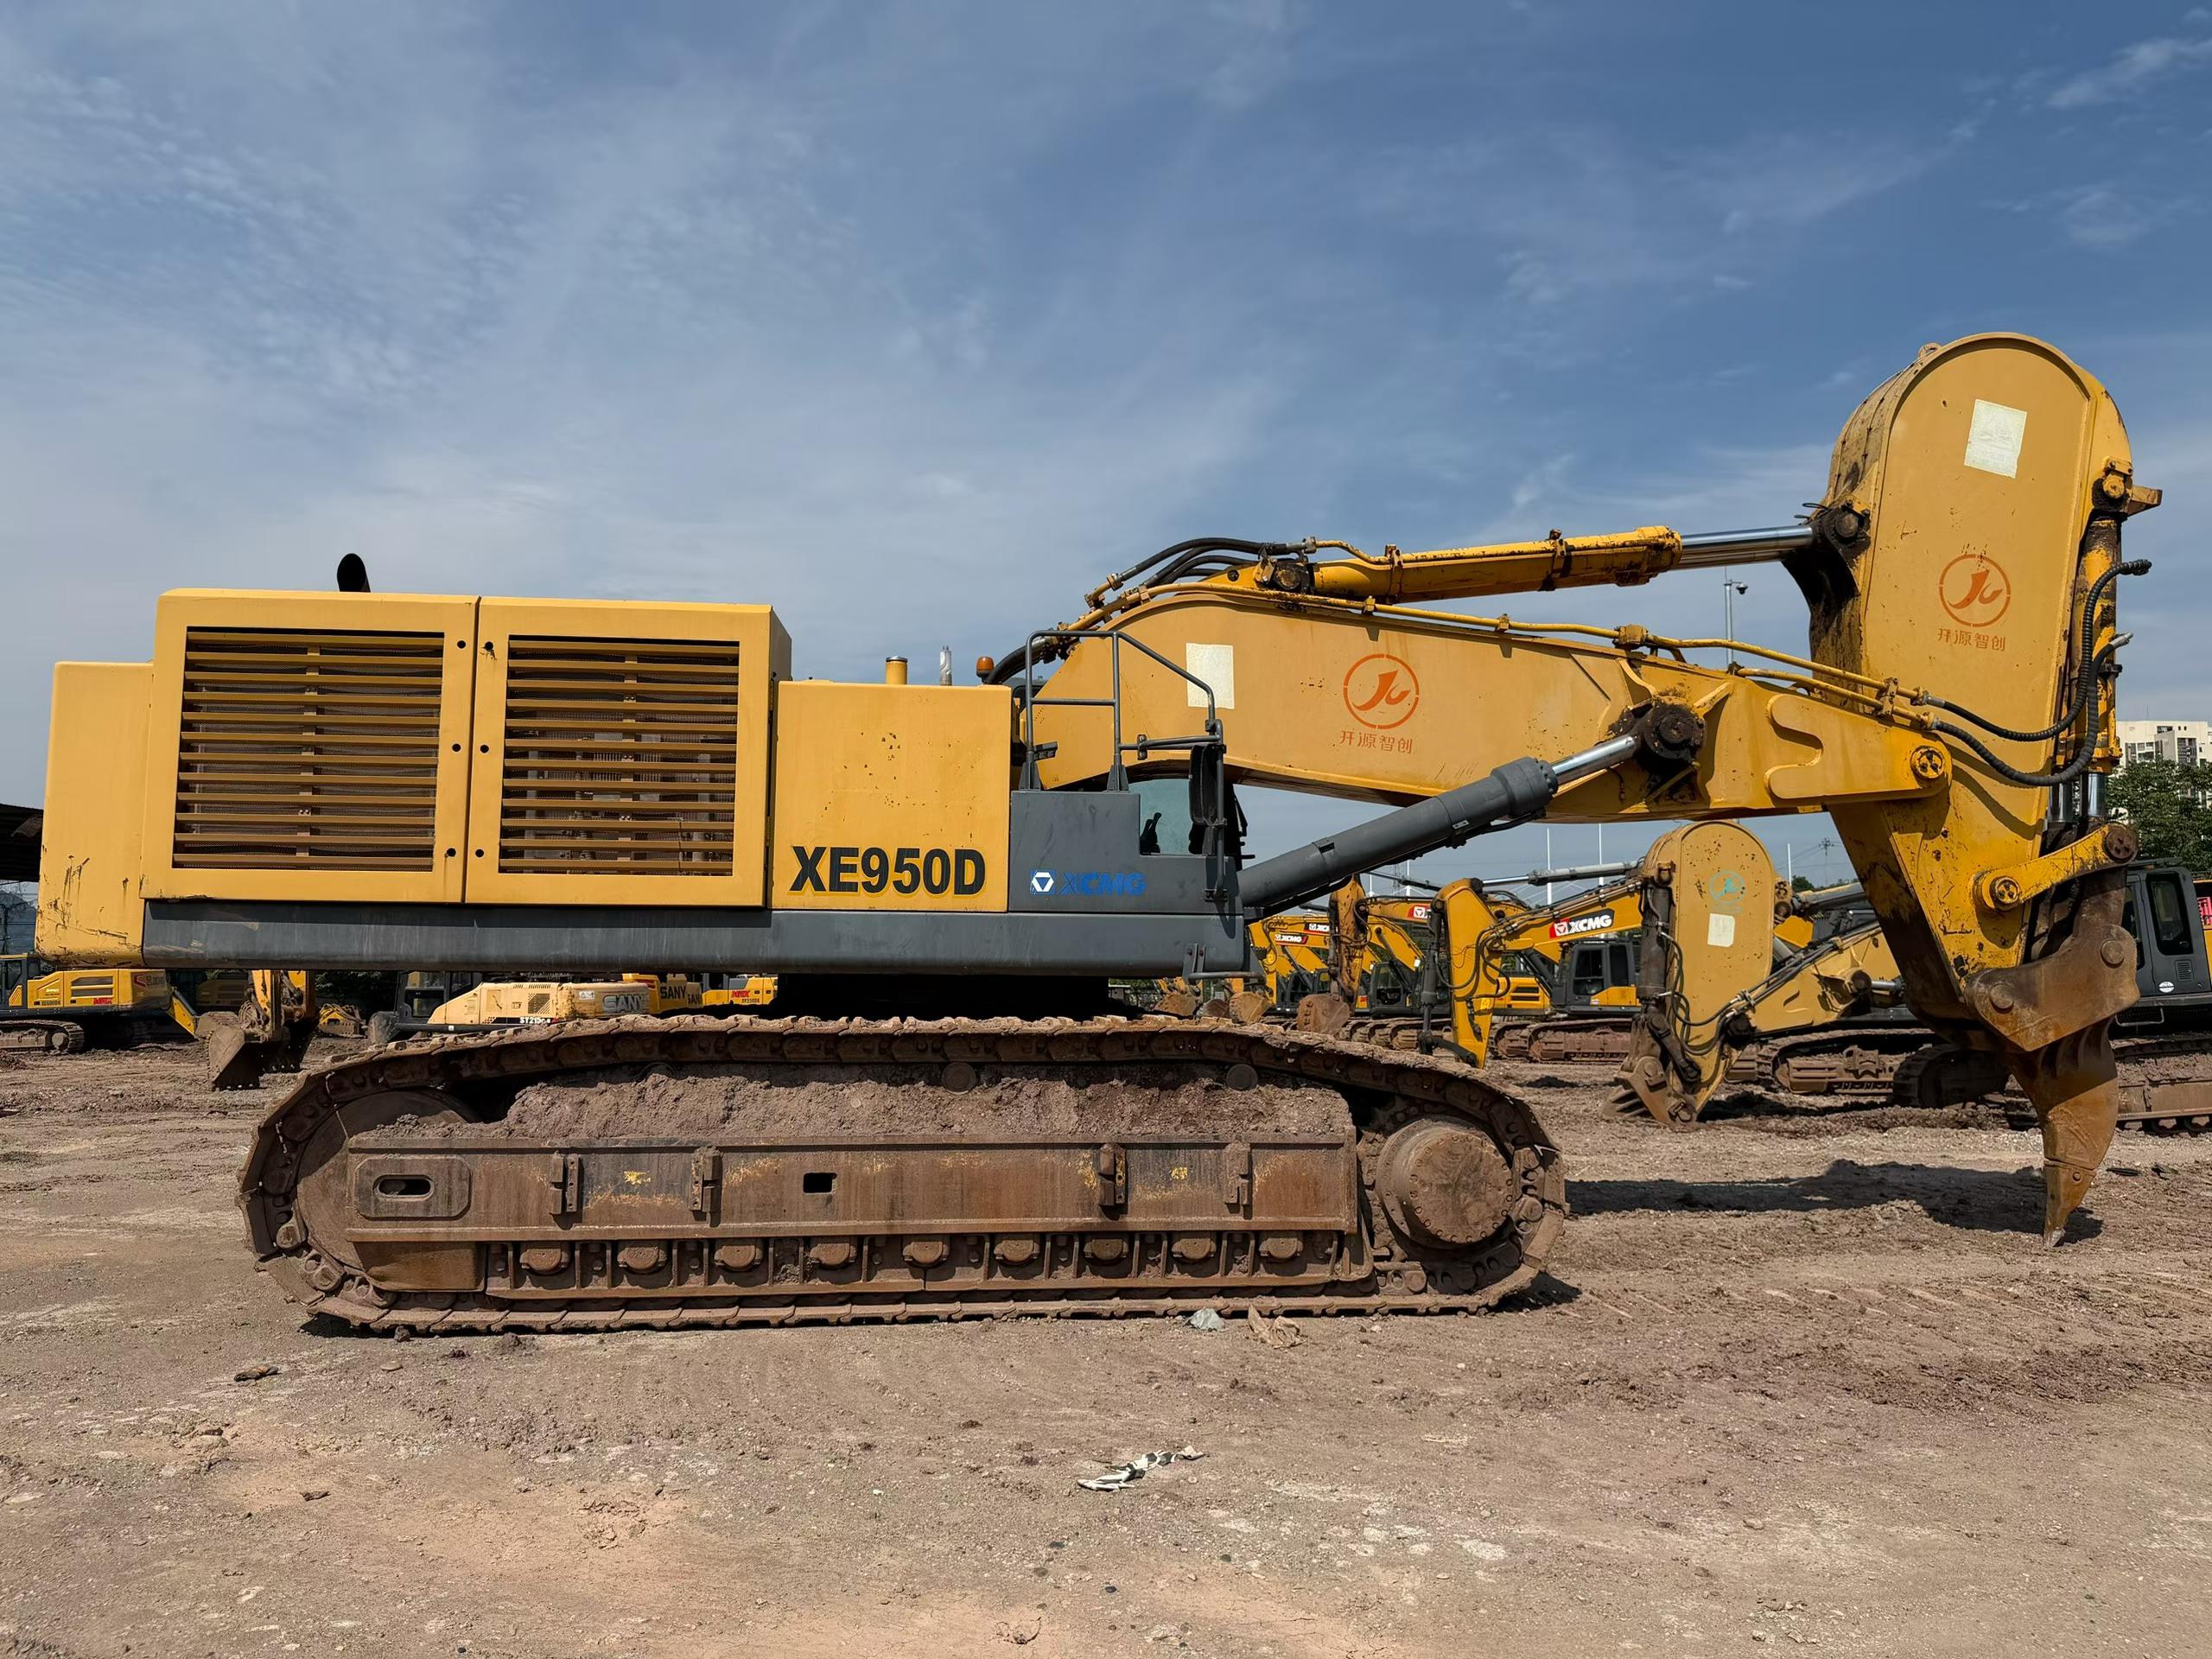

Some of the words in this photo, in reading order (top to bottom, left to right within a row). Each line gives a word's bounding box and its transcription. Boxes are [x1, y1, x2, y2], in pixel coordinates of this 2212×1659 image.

[1340, 730, 1413, 754] 开源智创
[790, 846, 986, 895] XE950D
[1056, 871, 1147, 895] XCMG
[1568, 915, 1612, 933] XCMG
[659, 986, 687, 1000] SANY
[603, 995, 644, 1014] SANY
